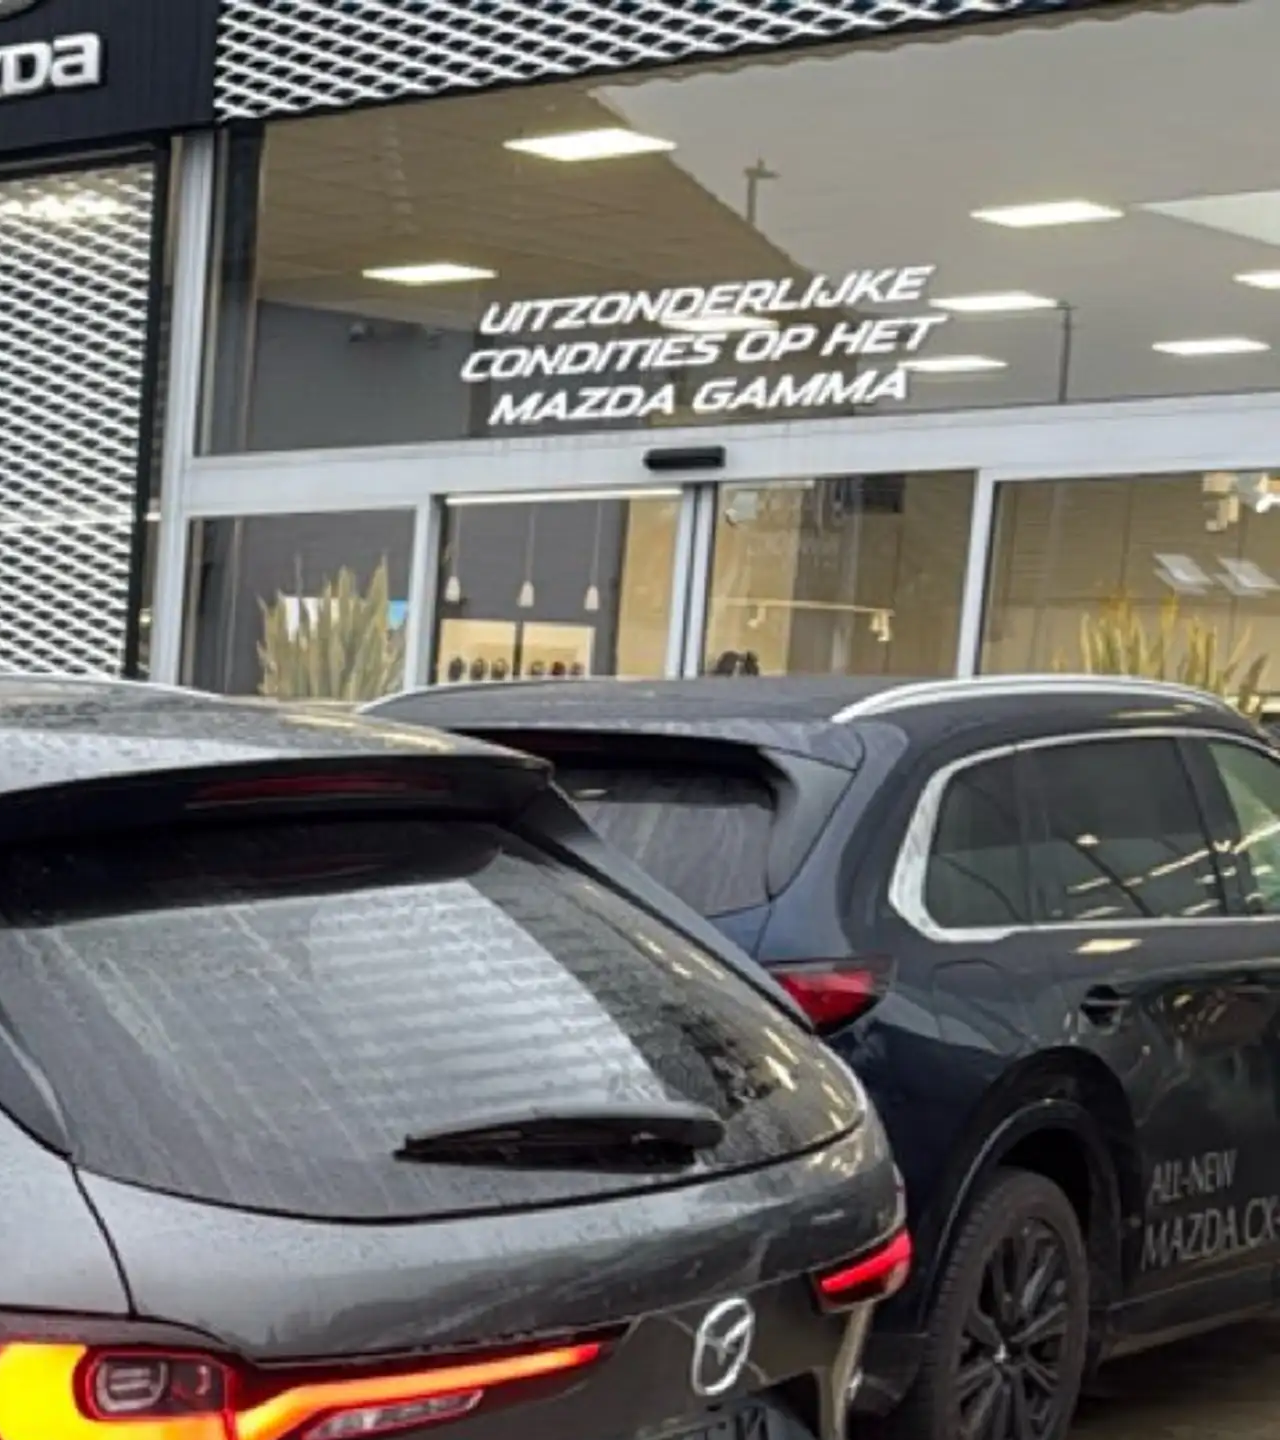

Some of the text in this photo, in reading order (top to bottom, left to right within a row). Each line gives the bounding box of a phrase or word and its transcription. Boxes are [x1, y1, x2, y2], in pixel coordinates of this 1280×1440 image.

[480, 265, 939, 336] UITZONDERLIJKE
[460, 314, 949, 383] CONDITIES OP HET
[488, 366, 910, 426] MAZDA GAMMA
[1146, 1148, 1237, 1206] ALL-NEW
[1140, 1205, 1240, 1273] MAZDA
